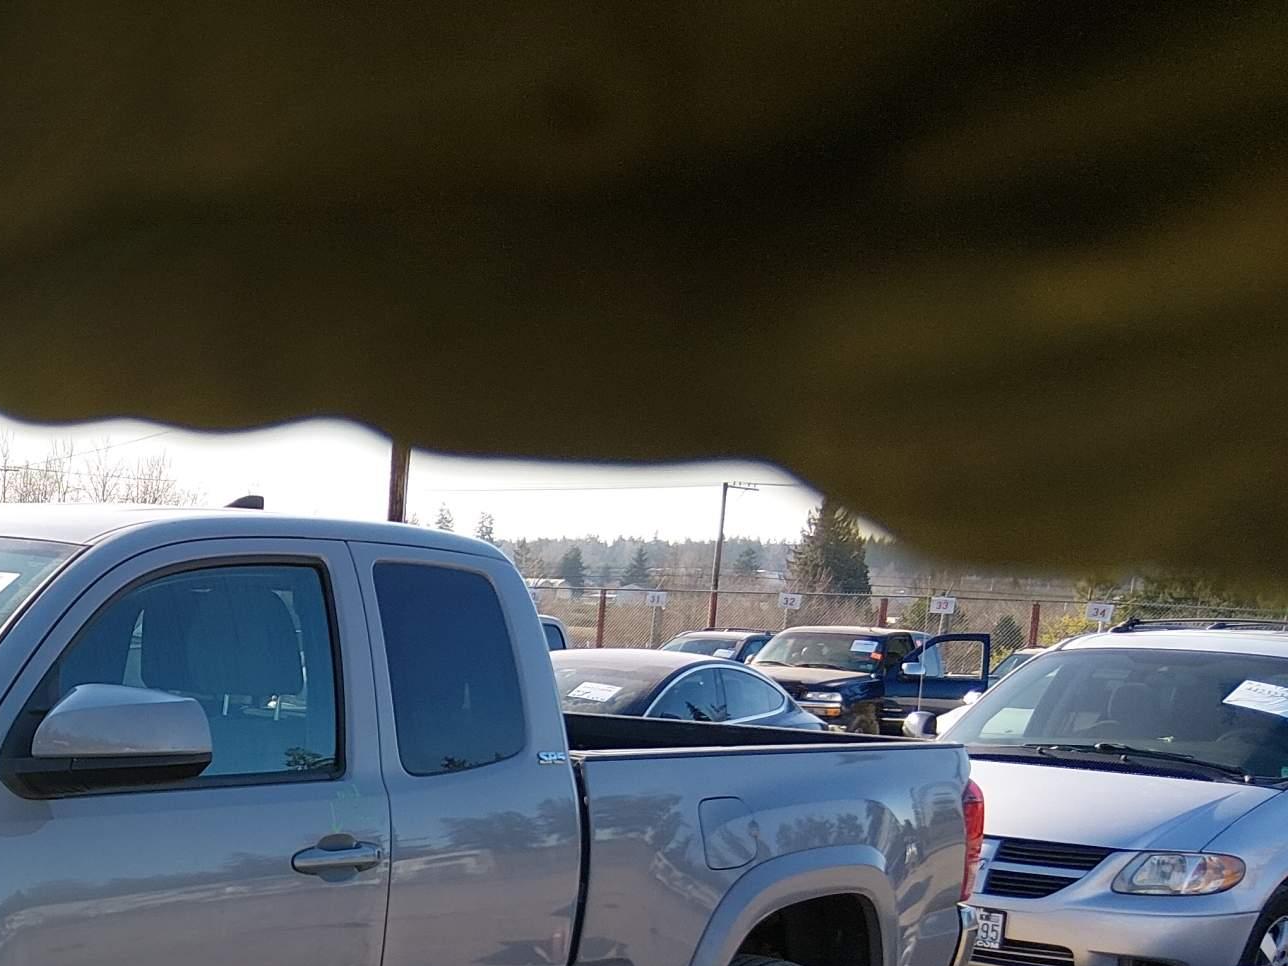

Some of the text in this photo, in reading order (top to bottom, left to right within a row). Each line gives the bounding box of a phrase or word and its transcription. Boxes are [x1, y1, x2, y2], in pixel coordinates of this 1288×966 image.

[649, 595, 661, 603] 31
[783, 597, 796, 606] 32
[935, 601, 949, 610] 33
[1092, 607, 1107, 618] 34
